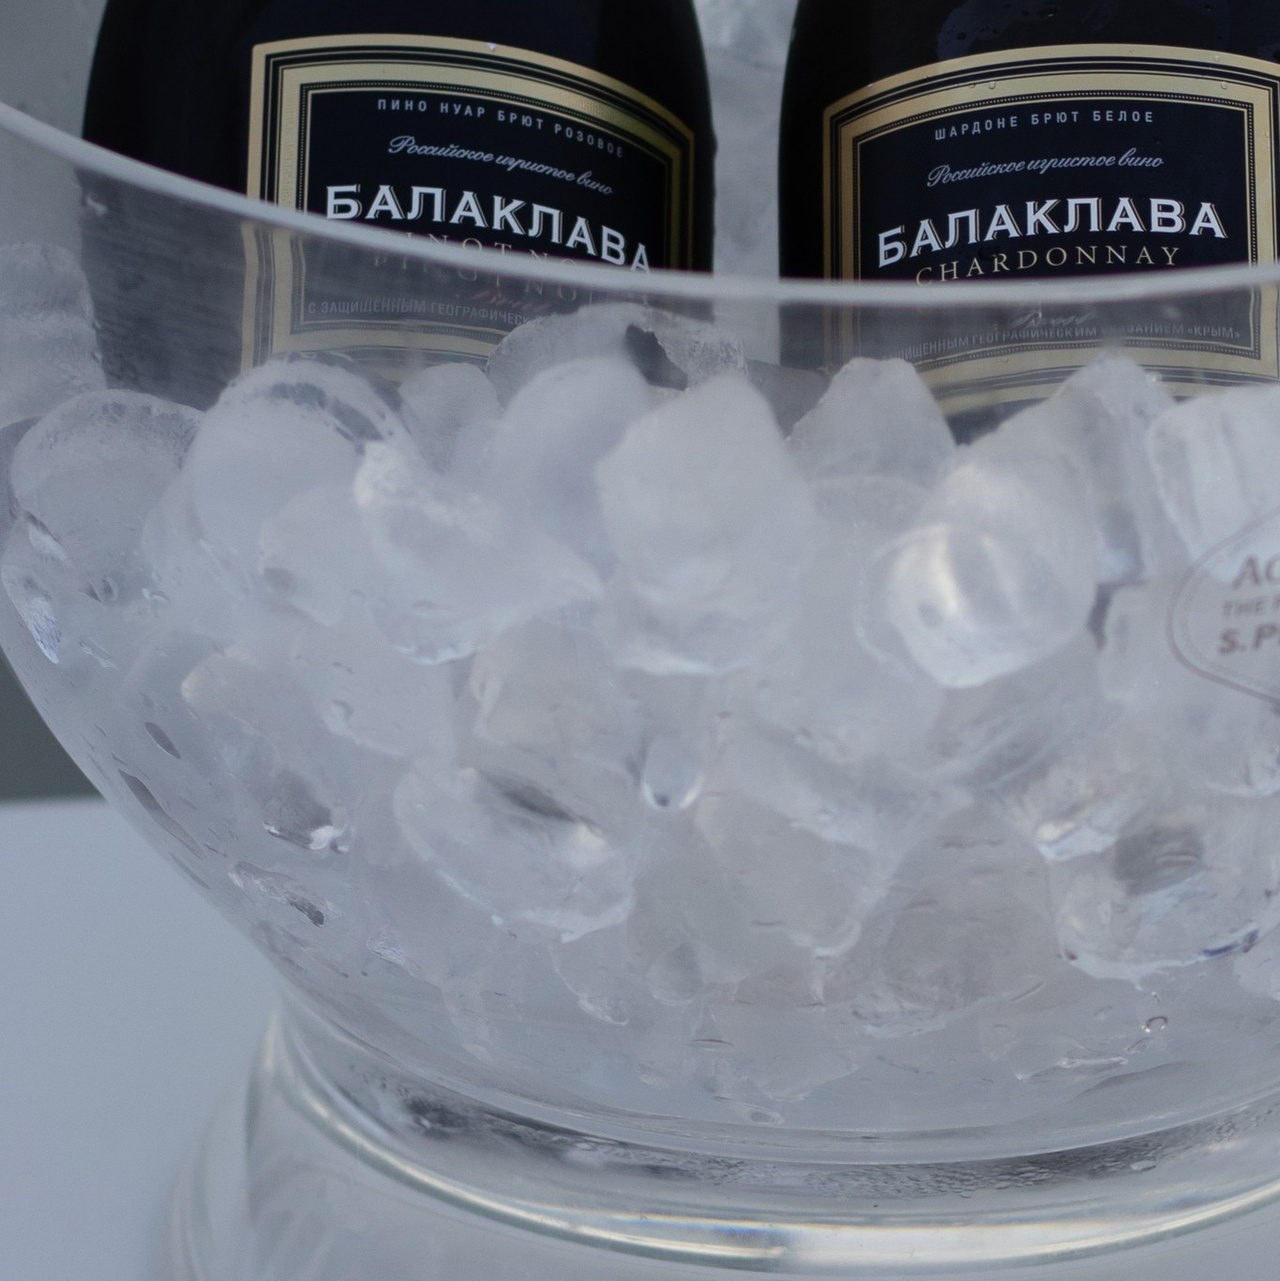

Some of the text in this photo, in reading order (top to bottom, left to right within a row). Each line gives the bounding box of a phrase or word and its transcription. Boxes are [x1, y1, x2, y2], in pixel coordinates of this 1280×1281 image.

[377, 98, 624, 159] ПИНО НУАР БРЮТ РОЗОВОЕ
[935, 110, 1154, 141] ШАРДОНЕ БРЮТ БЕЛОЕ
[388, 135, 615, 196] Российское игристое вино
[926, 147, 1165, 187] Российское игристое вино
[326, 184, 653, 274] БАЛАКЛАВА
[877, 196, 1229, 268] БАЛАКЛАВА
[916, 246, 1181, 286] CHARDONNAY
[1221, 595, 1267, 620] THE
